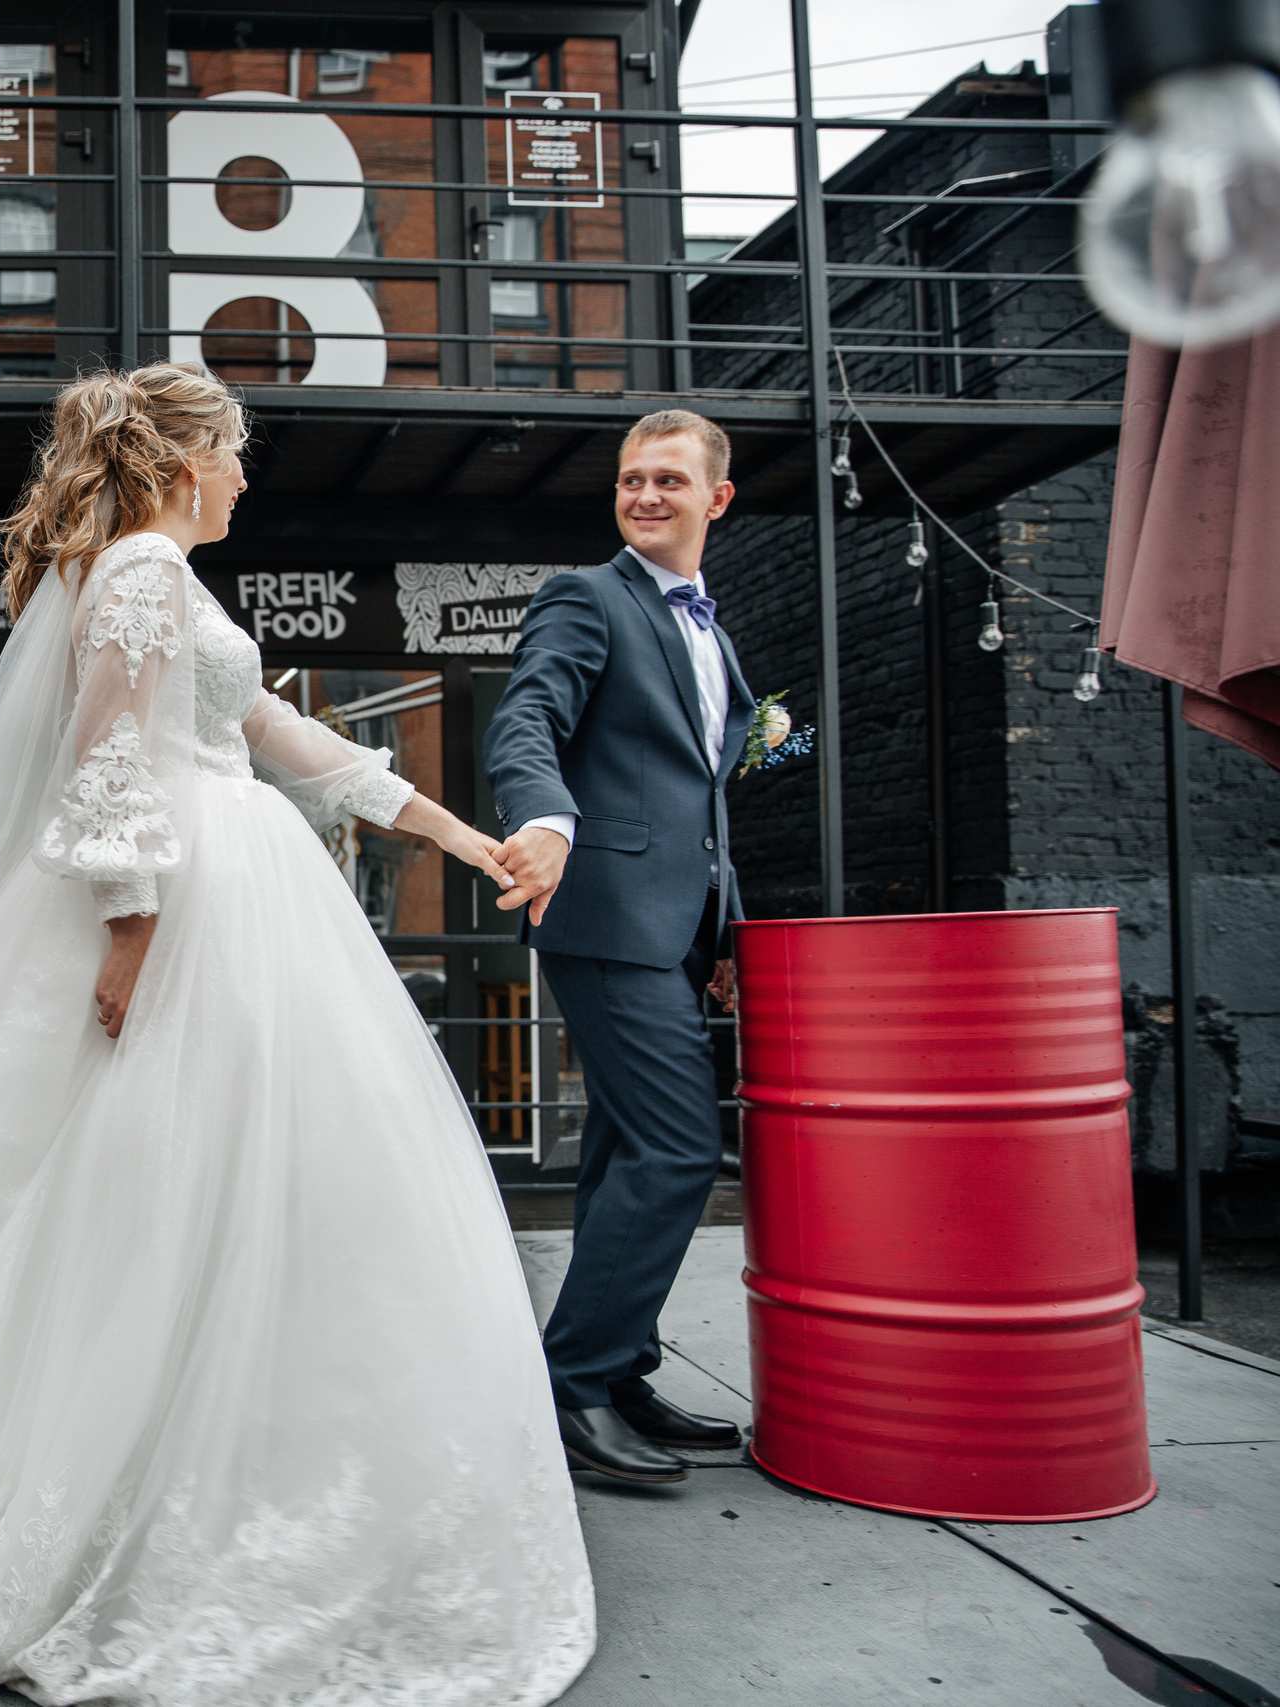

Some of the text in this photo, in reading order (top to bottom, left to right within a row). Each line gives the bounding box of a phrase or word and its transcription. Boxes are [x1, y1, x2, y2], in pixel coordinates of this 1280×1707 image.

[167, 90, 387, 386] 8
[237, 571, 357, 609] FREAK
[253, 605, 346, 643] FOOD
